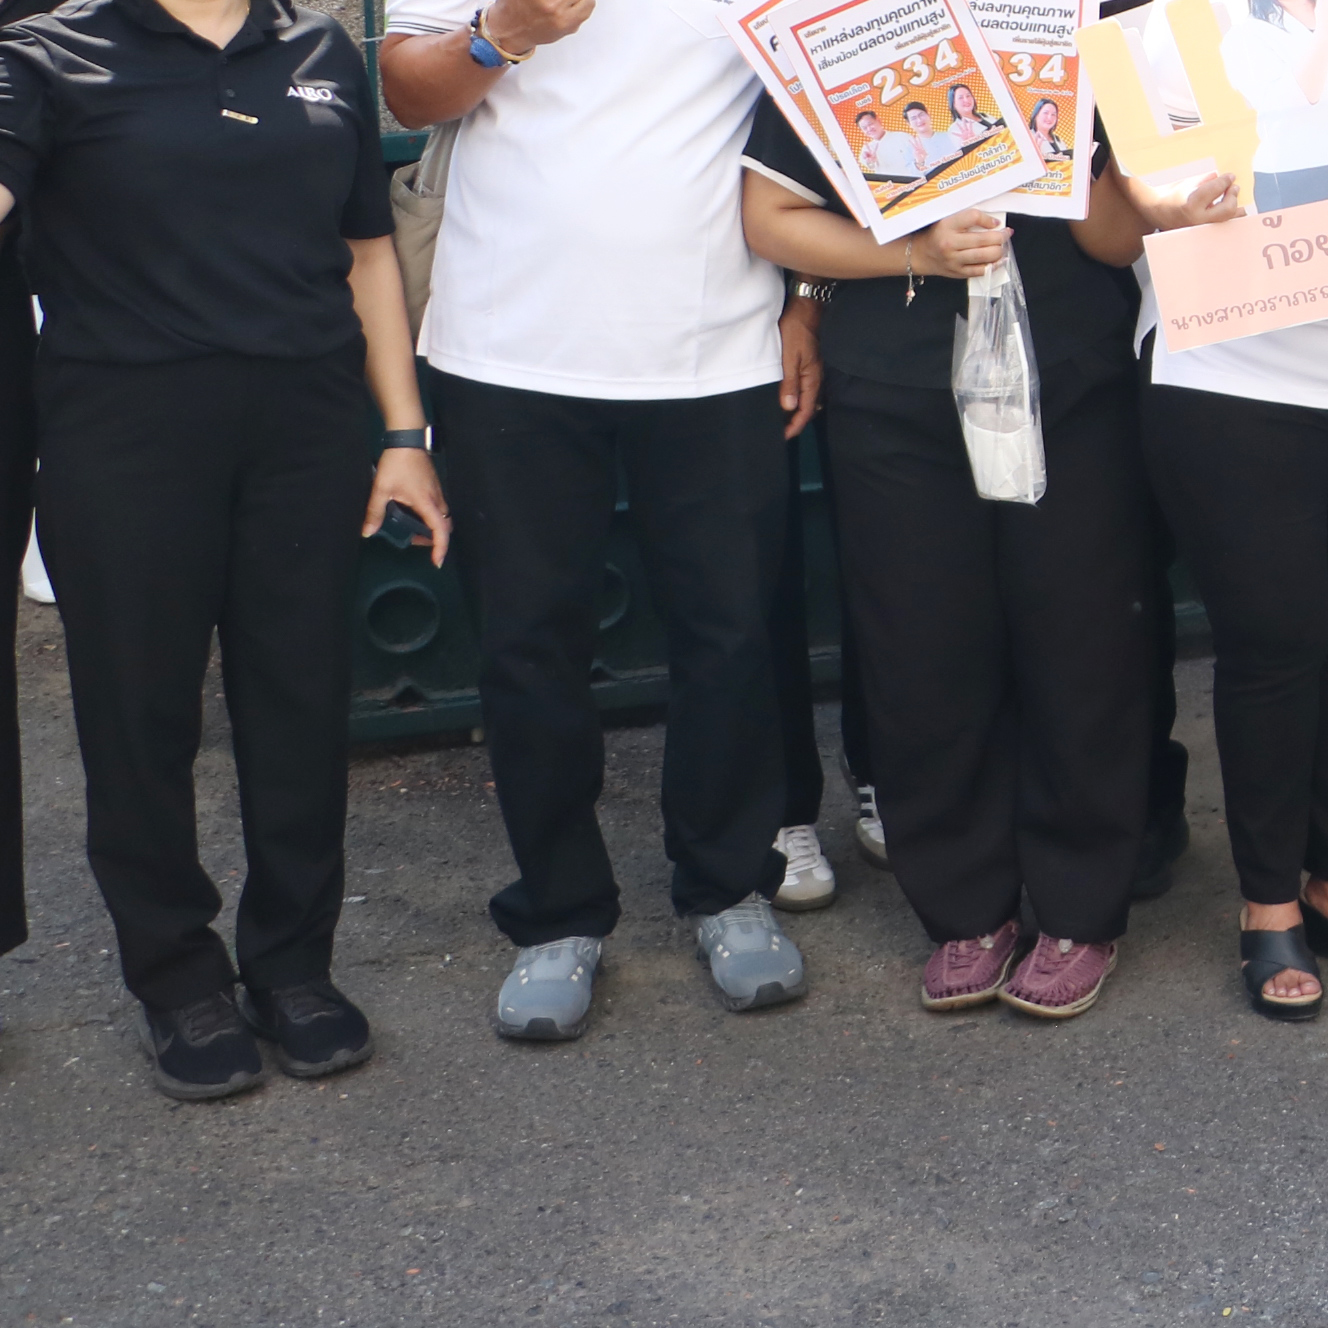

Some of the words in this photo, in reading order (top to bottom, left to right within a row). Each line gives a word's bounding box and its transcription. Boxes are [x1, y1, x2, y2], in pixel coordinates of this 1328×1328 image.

[872, 68, 909, 106] 2
[903, 53, 934, 87] 3
[935, 38, 963, 72] 4
[1008, 52, 1036, 86] 3
[1038, 53, 1068, 86] 4
